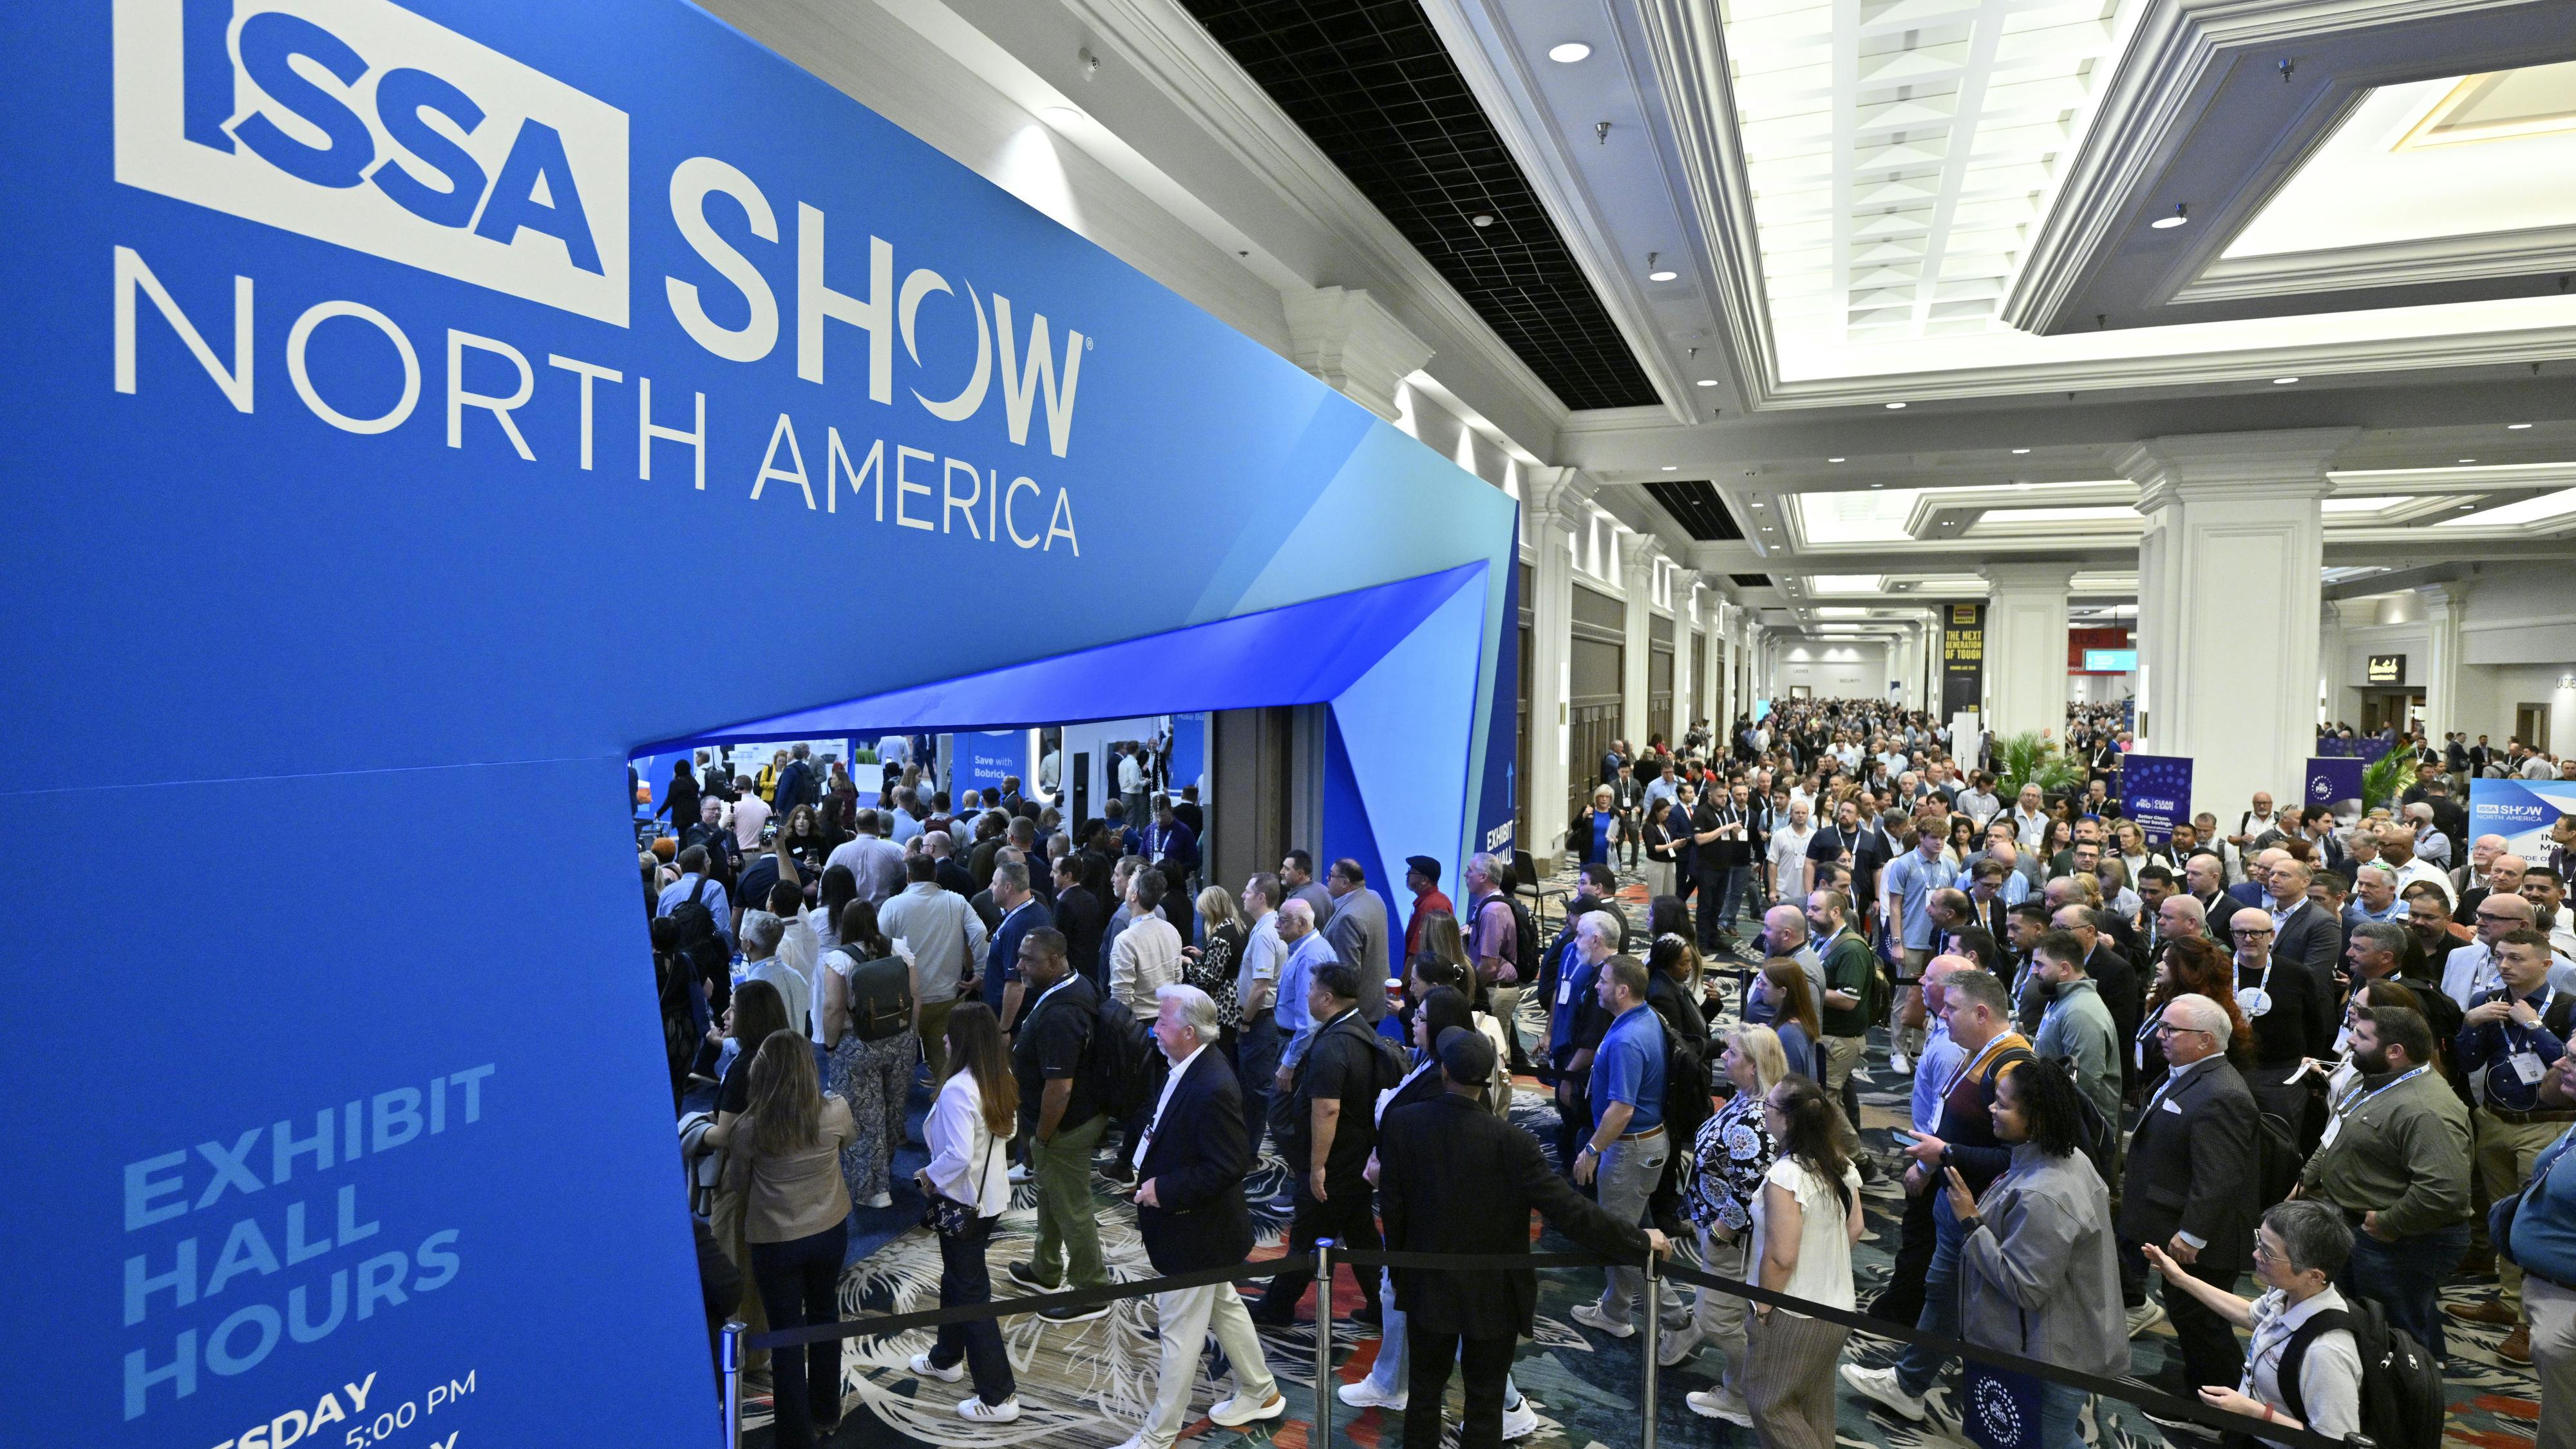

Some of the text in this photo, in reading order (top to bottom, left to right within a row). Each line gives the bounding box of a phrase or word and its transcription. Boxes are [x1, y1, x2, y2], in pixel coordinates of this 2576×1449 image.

[183, 0, 605, 276] ISSA
[115, 246, 1079, 557] NORTH AMERICA
[1946, 630, 1982, 641] THE NEXT
[1946, 641, 1982, 649] GENERATION
[1945, 649, 1982, 659] OF TOUGH
[975, 755, 1012, 766] Save with
[974, 768, 1005, 779] Bobrick
[2501, 805, 2543, 815] SHOW
[1487, 819, 1513, 852] EXHIBIT
[1987, 1034, 2005, 1047] ECOLAB
[2400, 1068, 2423, 1081] ECOLAB
[126, 1063, 495, 1231] EXHIBIT
[126, 1183, 379, 1326] HALL
[126, 1229, 460, 1420] HOURS
[346, 1369, 475, 1449] 5:00 PM
[1989, 1402, 2008, 1423] PRO
